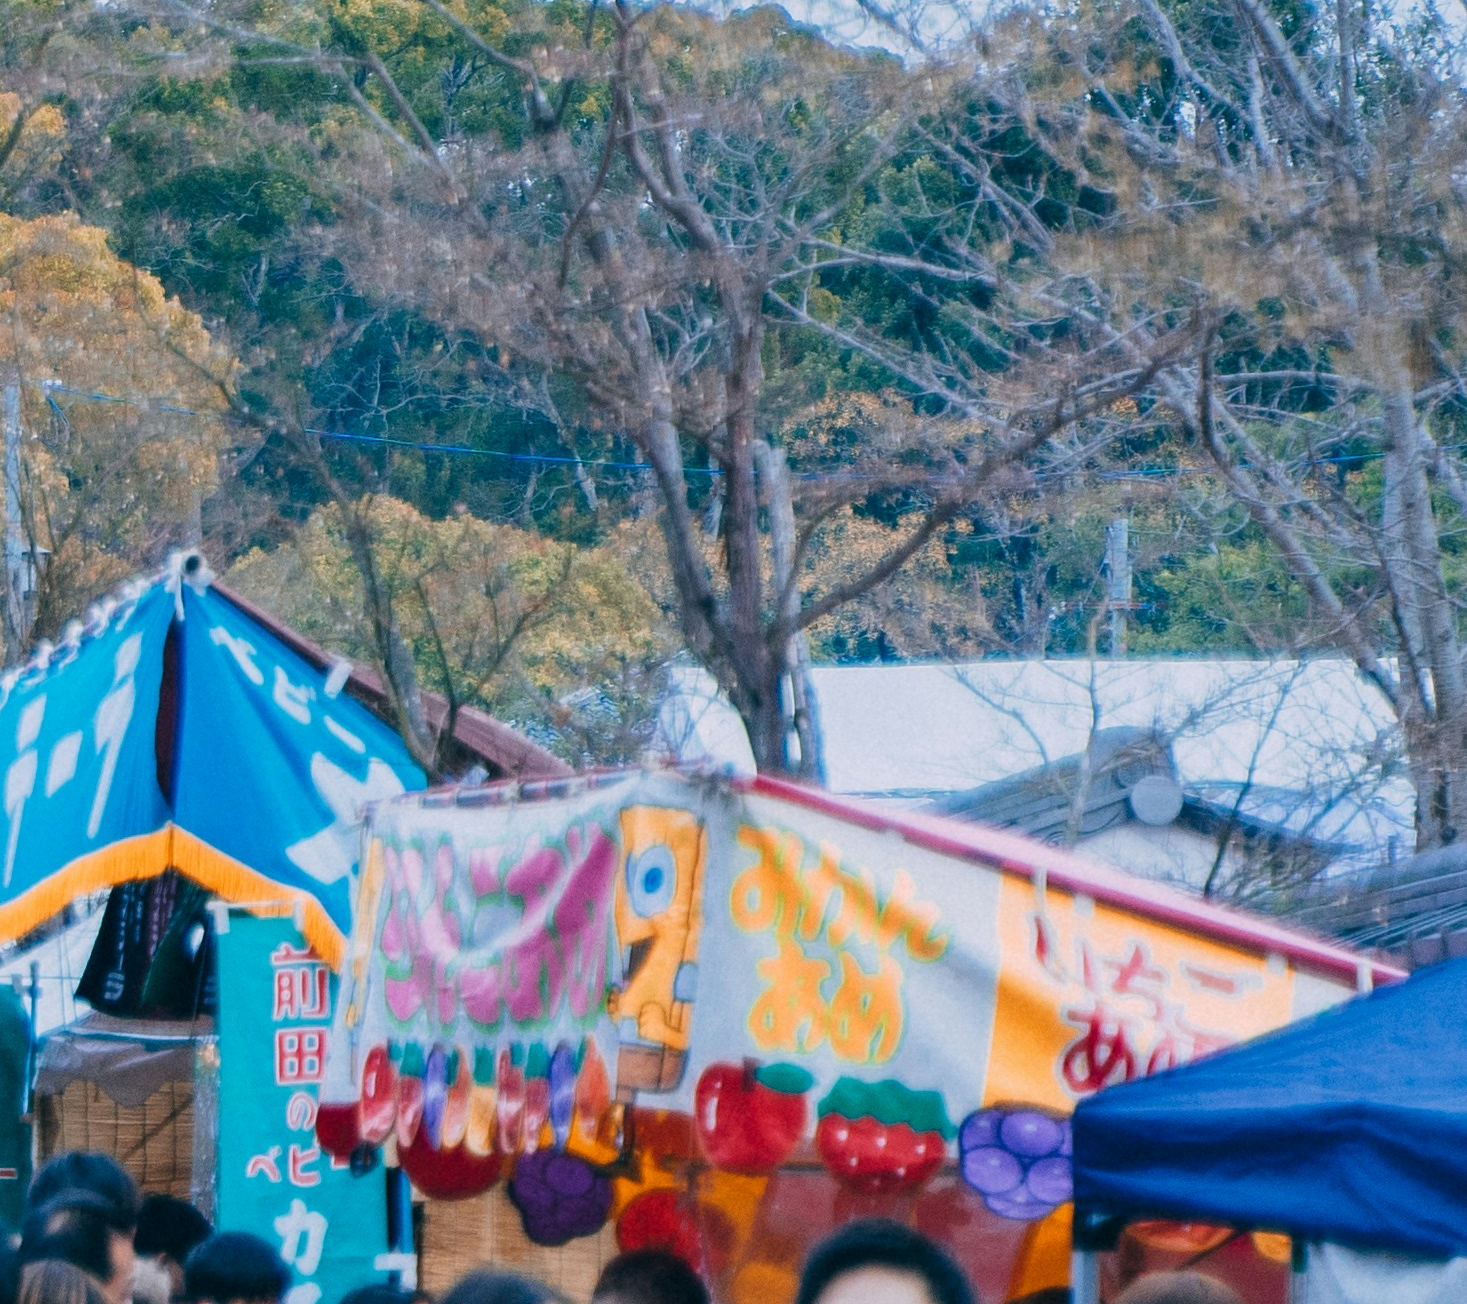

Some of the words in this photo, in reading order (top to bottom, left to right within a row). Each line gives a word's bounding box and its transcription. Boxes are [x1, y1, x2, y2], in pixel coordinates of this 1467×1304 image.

[208, 625, 367, 755] ベビー
[729, 824, 949, 962] みかん
[270, 942, 330, 1132] 前田の
[748, 944, 904, 1065] あめ
